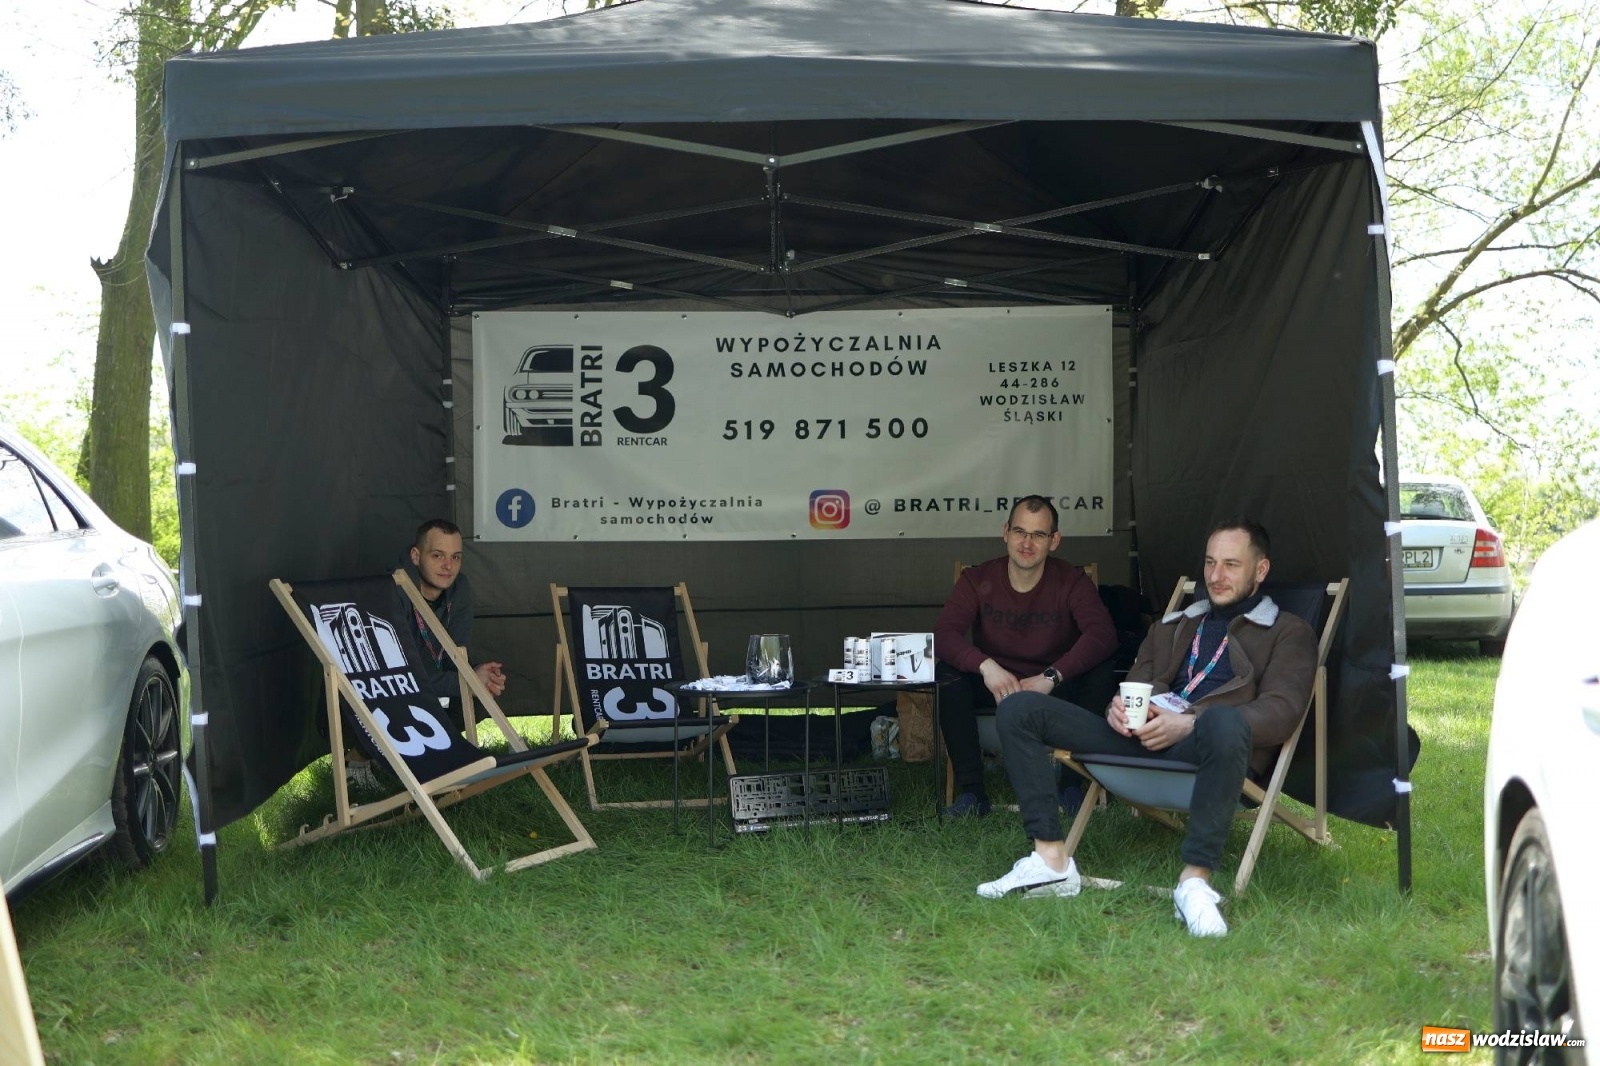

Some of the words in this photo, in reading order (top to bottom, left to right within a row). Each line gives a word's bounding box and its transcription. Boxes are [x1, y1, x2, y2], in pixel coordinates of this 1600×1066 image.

[715, 332, 942, 353] WYPOŻYCZALNIA
[730, 355, 928, 378] SAMOCHODÓW
[989, 360, 1053, 373] LESZKA
[1061, 360, 1076, 371] 12
[612, 344, 676, 434] 3
[999, 377, 1060, 389] 44-286
[580, 345, 603, 446] BRATRI
[979, 393, 1085, 406] WODZISŁAW
[1003, 409, 1063, 425] ŚLĄSKI
[722, 419, 775, 440] 519
[794, 418, 847, 440] 871
[865, 417, 929, 439] 500
[616, 436, 668, 446] RENTCAR
[551, 496, 604, 508] Bratri
[628, 495, 763, 511] Wypożyczalnia
[864, 499, 882, 515] @
[894, 495, 1104, 513] BRATRI_RCAR
[600, 512, 714, 525] samochodów
[1402, 551, 1430, 564] PL2
[585, 662, 673, 680] BRATRI
[846, 670, 854, 680] 3
[349, 672, 420, 700] RATRI
[603, 686, 680, 720] 3
[1135, 696, 1144, 708] 3
[371, 705, 452, 757] 3
